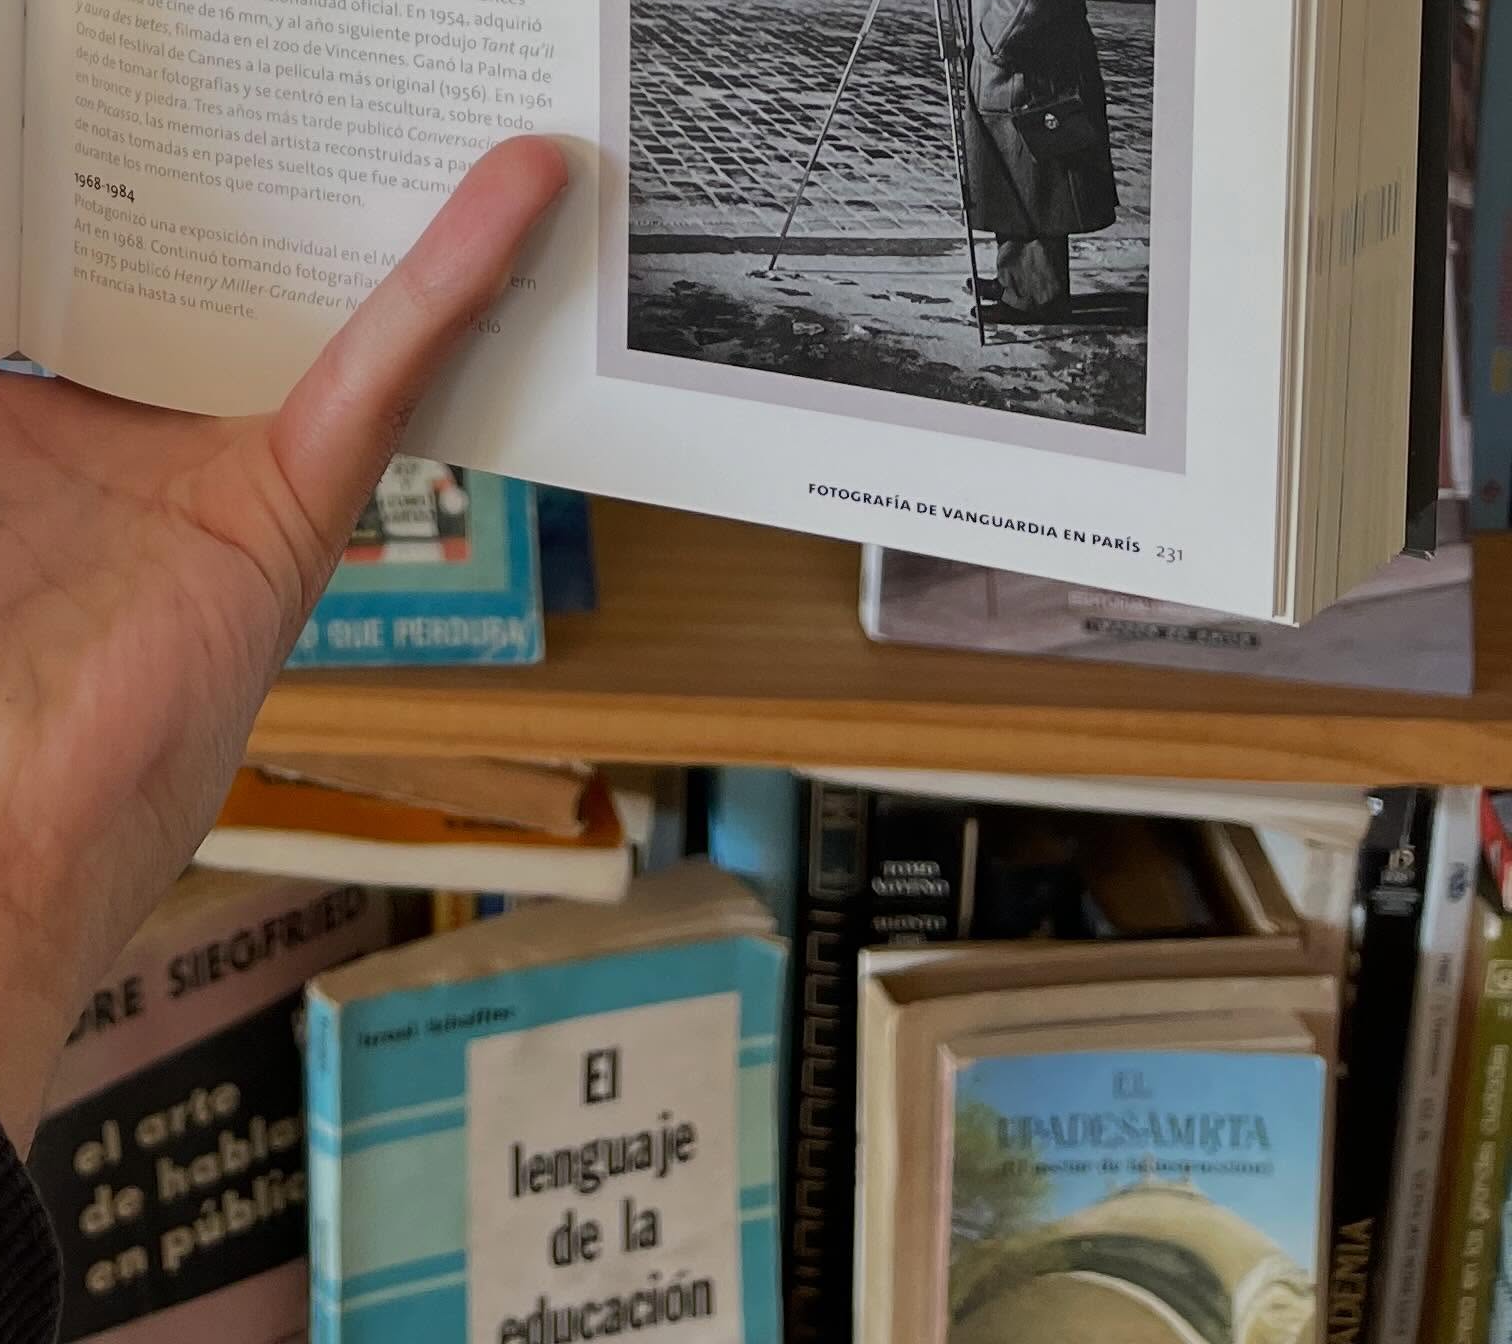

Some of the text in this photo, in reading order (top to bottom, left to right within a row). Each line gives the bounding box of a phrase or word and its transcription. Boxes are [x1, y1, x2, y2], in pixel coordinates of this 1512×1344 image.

[74, 171, 136, 204] 1968-1984
[807, 482, 1183, 564] FOTOGRAFÍA DE VANGUARDIA EN PARÍS 231
[583, 1048, 621, 1106] El
[73, 1081, 241, 1178] el arte
[510, 1111, 698, 1199] lenguaje
[78, 1114, 303, 1239] de habla
[85, 1245, 148, 1294] en
[550, 1197, 662, 1268] de la
[500, 1269, 717, 1344] educación
